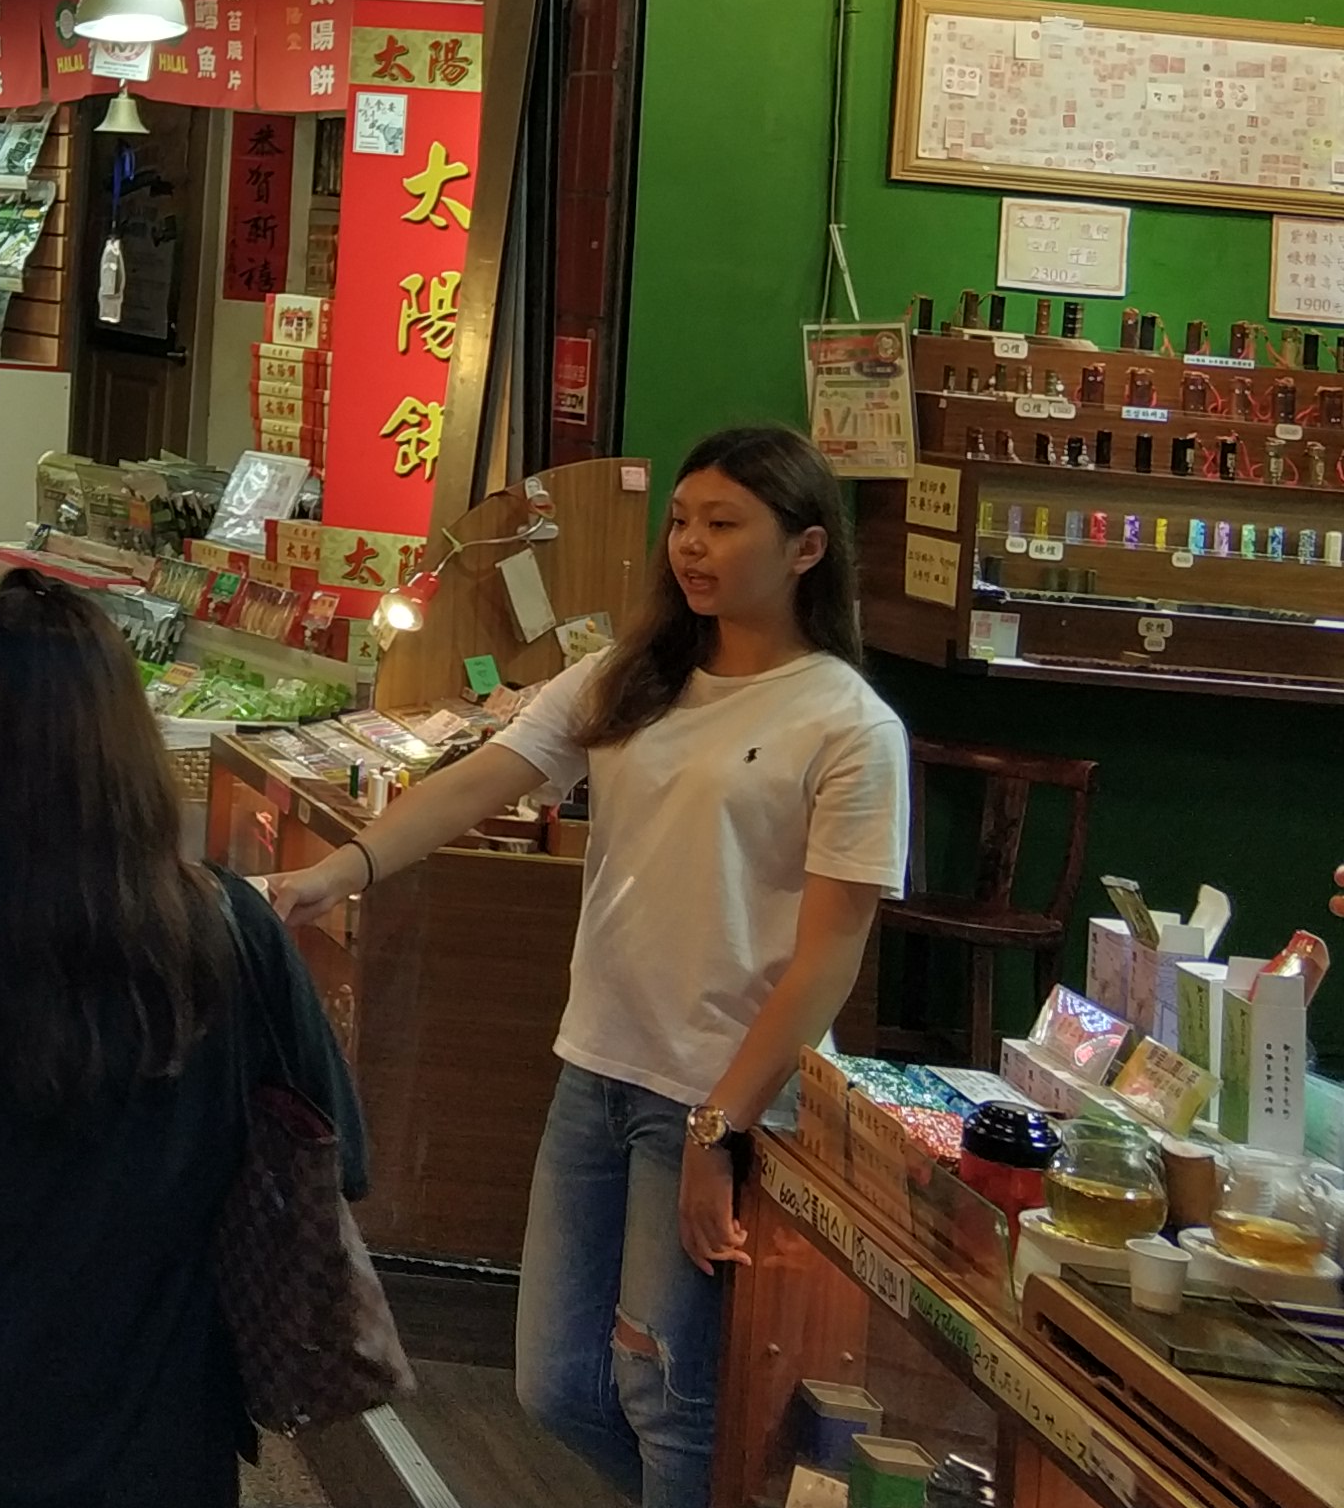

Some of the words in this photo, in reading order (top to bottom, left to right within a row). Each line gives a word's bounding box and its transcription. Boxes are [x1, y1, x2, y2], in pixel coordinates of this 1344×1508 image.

[56, 53, 85, 74] HALAL
[158, 52, 189, 75] HALAL
[372, 34, 473, 86] 太陽
[239, 123, 284, 294] 恭賀新禧
[378, 140, 472, 482] 太陽餅
